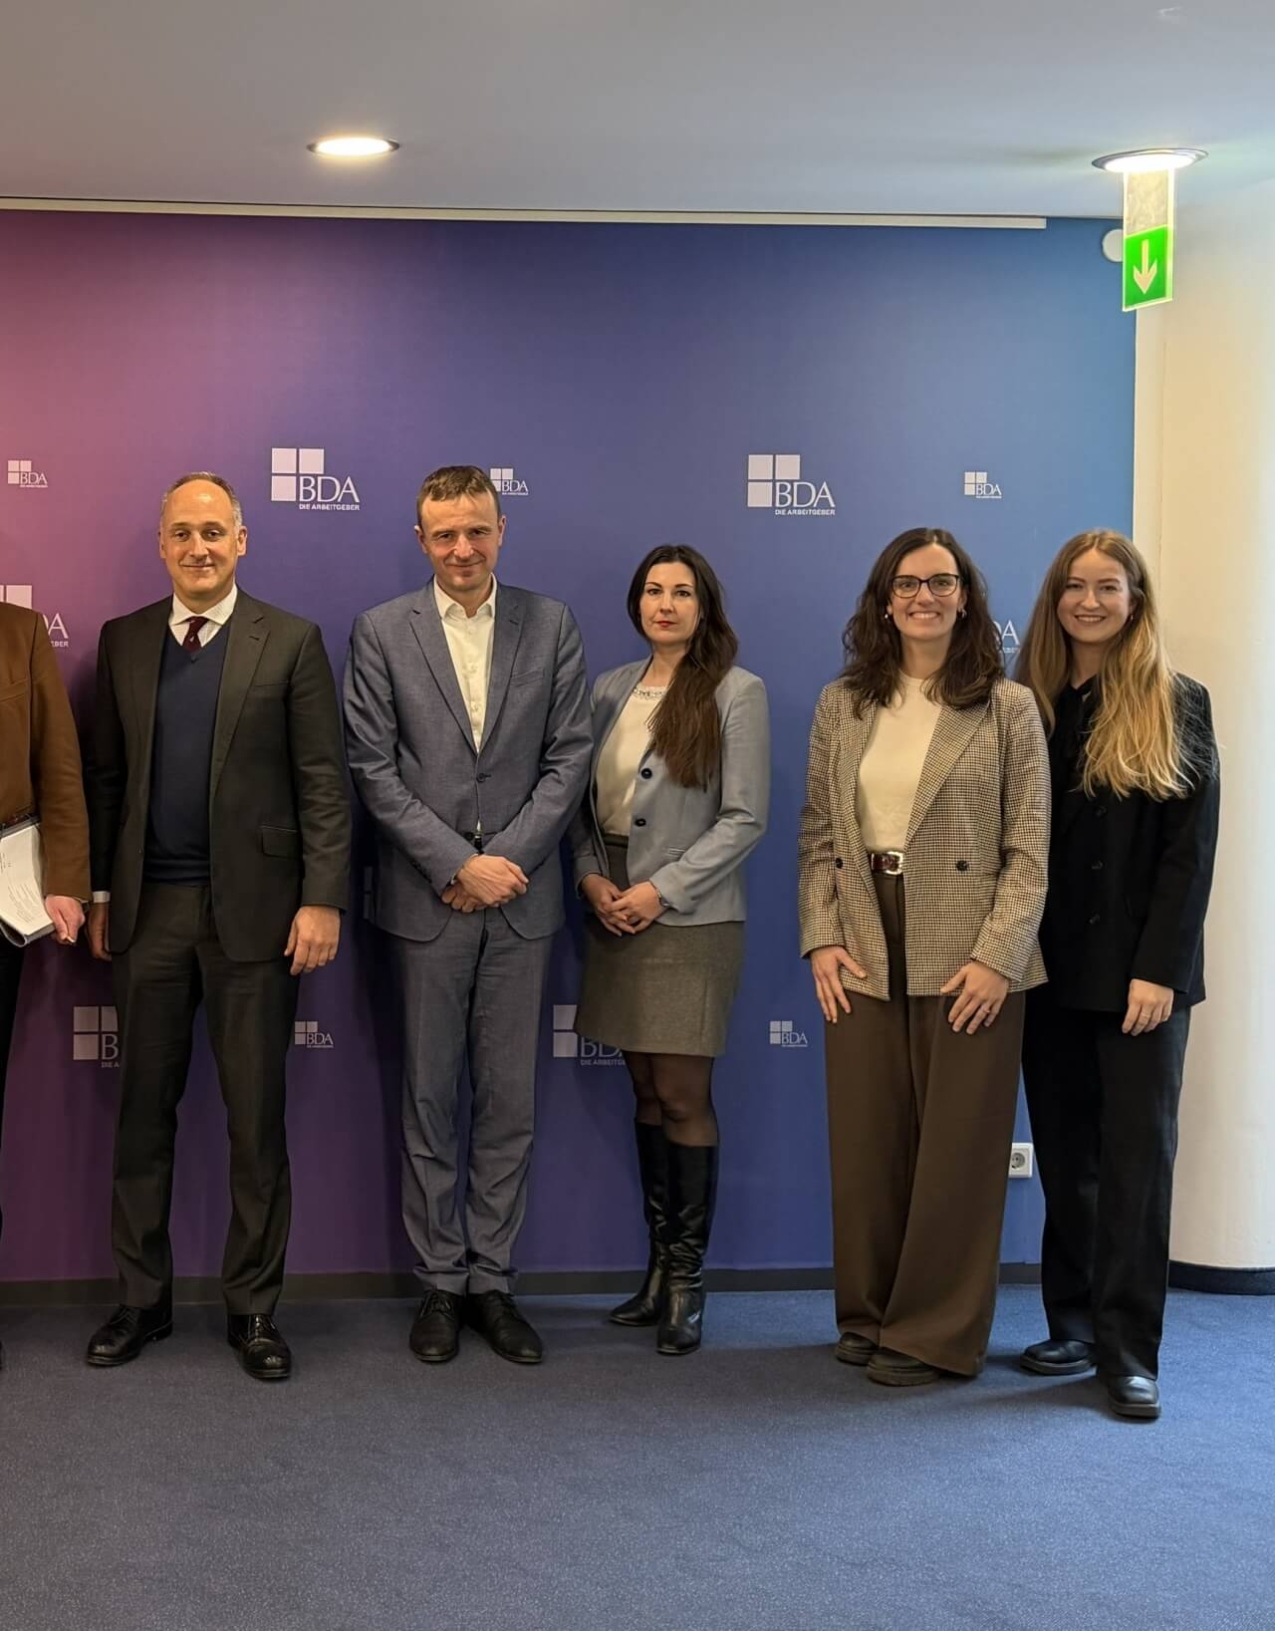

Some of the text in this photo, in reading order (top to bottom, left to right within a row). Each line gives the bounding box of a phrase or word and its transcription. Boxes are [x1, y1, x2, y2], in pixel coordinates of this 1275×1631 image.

[20, 472, 48, 485] BDA
[299, 476, 360, 502] BDA
[502, 480, 528, 492] BDA
[976, 483, 1002, 495] BDA
[775, 481, 836, 508] BDA
[311, 503, 360, 511] ARBEITGEBER
[306, 1032, 334, 1045] BDA
[781, 1032, 808, 1045] BDA
